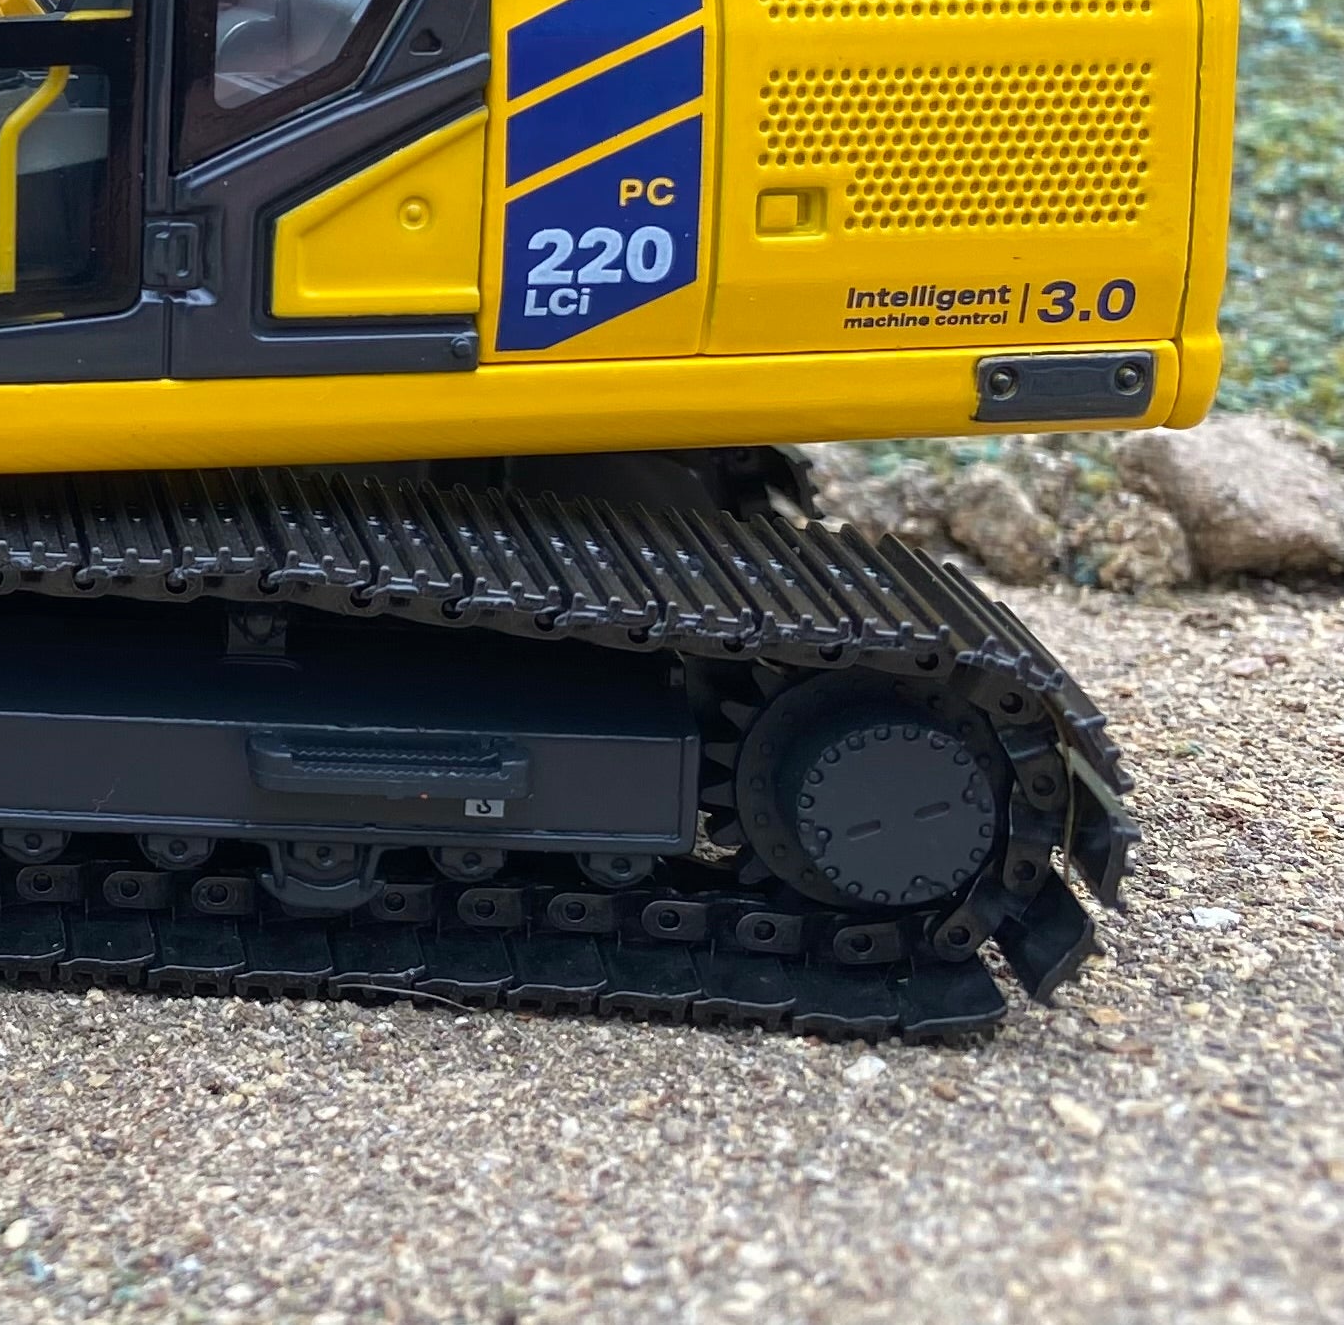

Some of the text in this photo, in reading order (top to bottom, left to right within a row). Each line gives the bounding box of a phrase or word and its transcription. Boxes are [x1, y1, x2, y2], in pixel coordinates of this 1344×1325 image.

[619, 177, 675, 207] PC
[527, 225, 674, 285] 220
[523, 287, 591, 317] LCi
[846, 278, 1137, 323] Intelligent 3.0
[843, 310, 1008, 329] machine control
